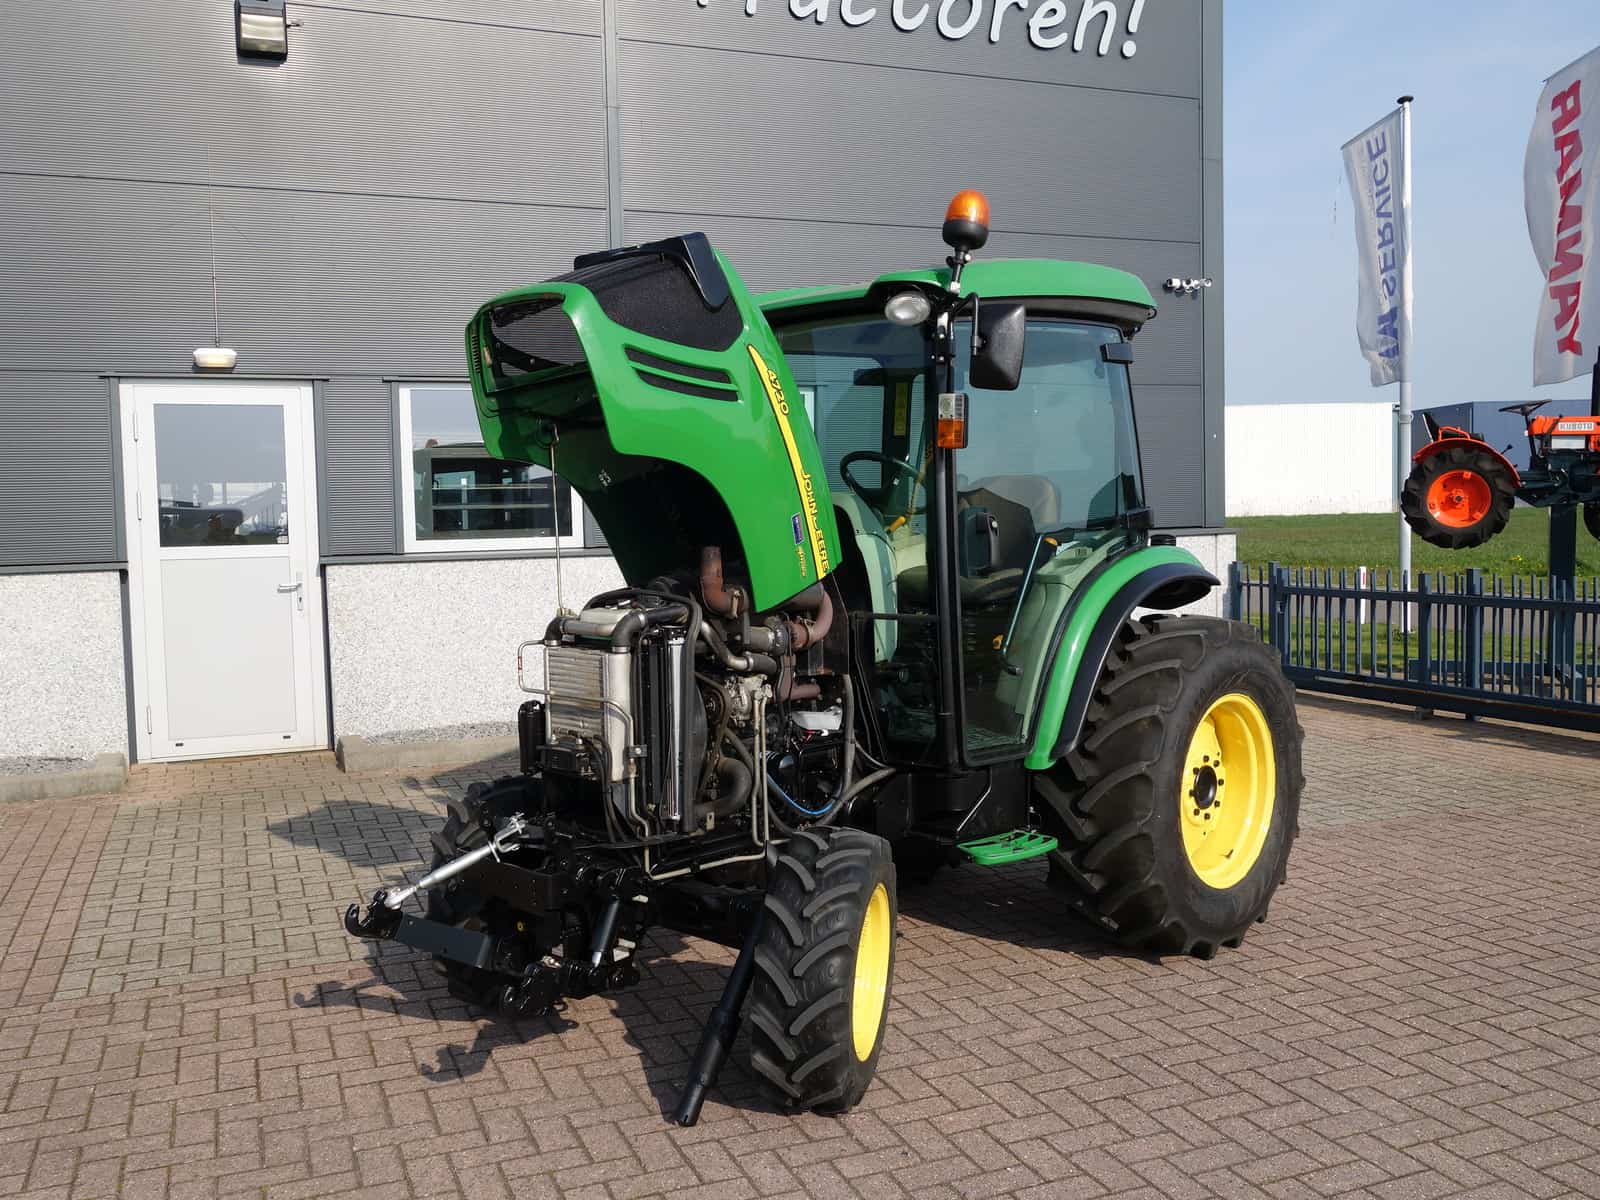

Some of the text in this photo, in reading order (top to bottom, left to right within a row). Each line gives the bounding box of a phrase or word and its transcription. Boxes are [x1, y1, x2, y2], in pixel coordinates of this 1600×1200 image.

[697, 0, 1145, 57] acoren!
[767, 368, 789, 415] 4720
[801, 470, 830, 572] JOHN EERE
